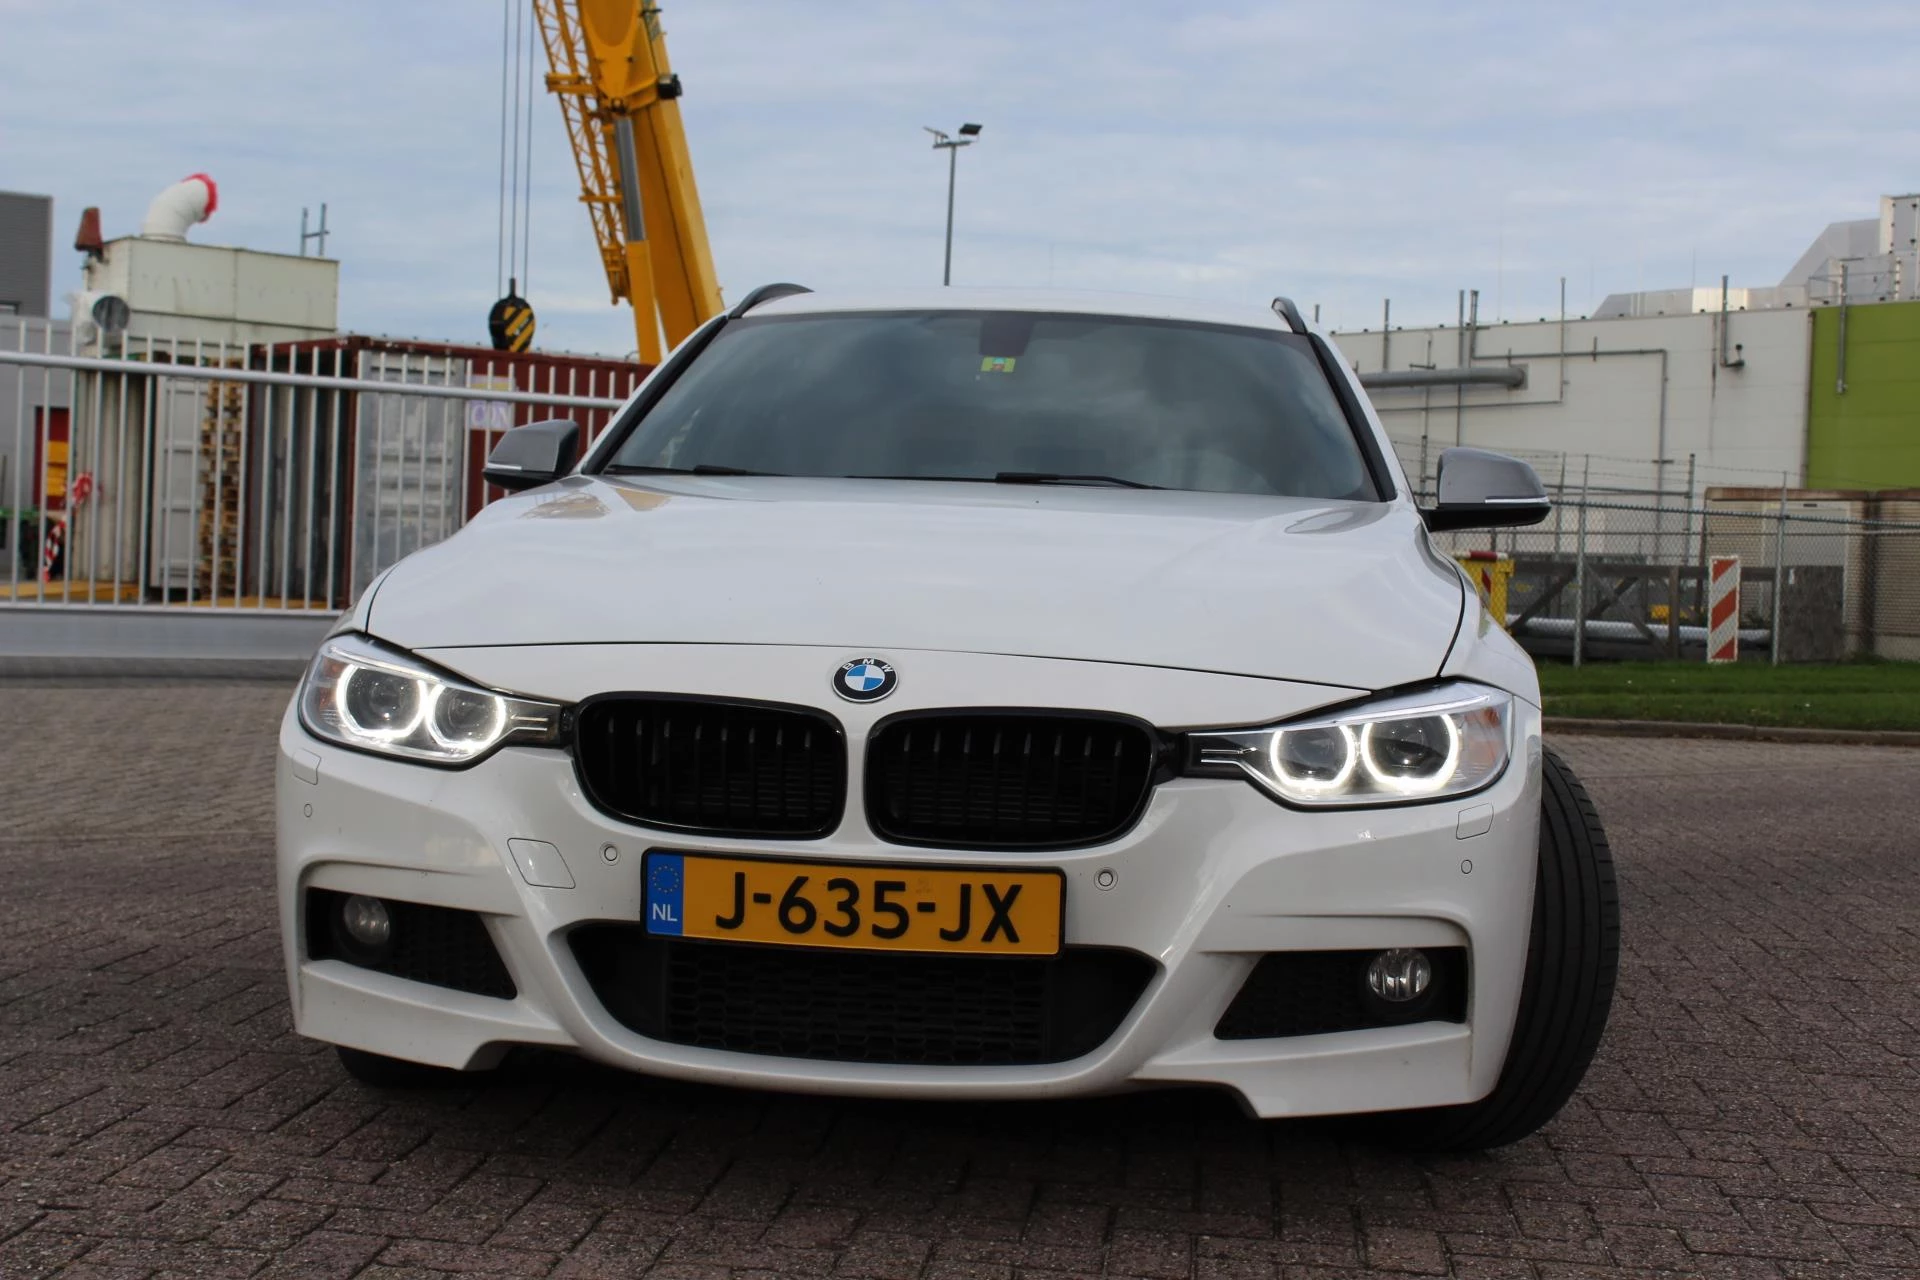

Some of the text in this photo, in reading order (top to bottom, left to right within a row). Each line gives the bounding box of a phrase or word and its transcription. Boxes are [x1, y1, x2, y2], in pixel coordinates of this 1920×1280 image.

[842, 658, 894, 673] BMW
[652, 902, 678, 922] NL
[715, 871, 1023, 944] J-635-JX
